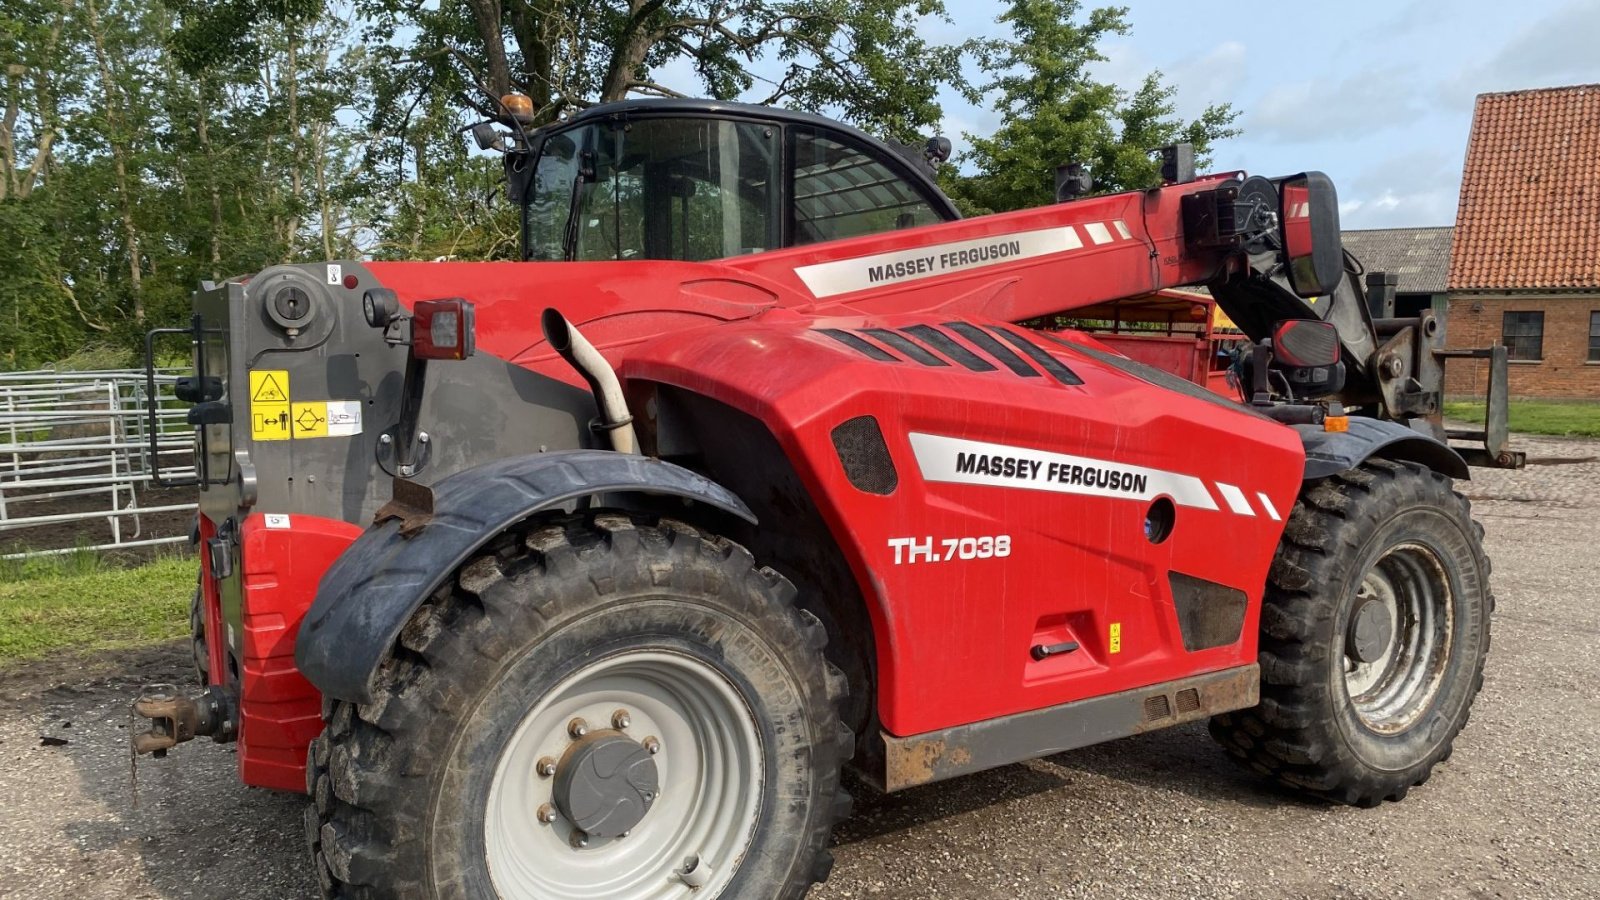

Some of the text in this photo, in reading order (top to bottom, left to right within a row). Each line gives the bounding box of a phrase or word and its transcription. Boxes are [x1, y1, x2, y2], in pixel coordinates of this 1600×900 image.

[868, 240, 1021, 282] MASSEY FERGUSON
[955, 452, 1147, 493] MASSEY FERGUSON
[887, 535, 1011, 565] TH.7038
